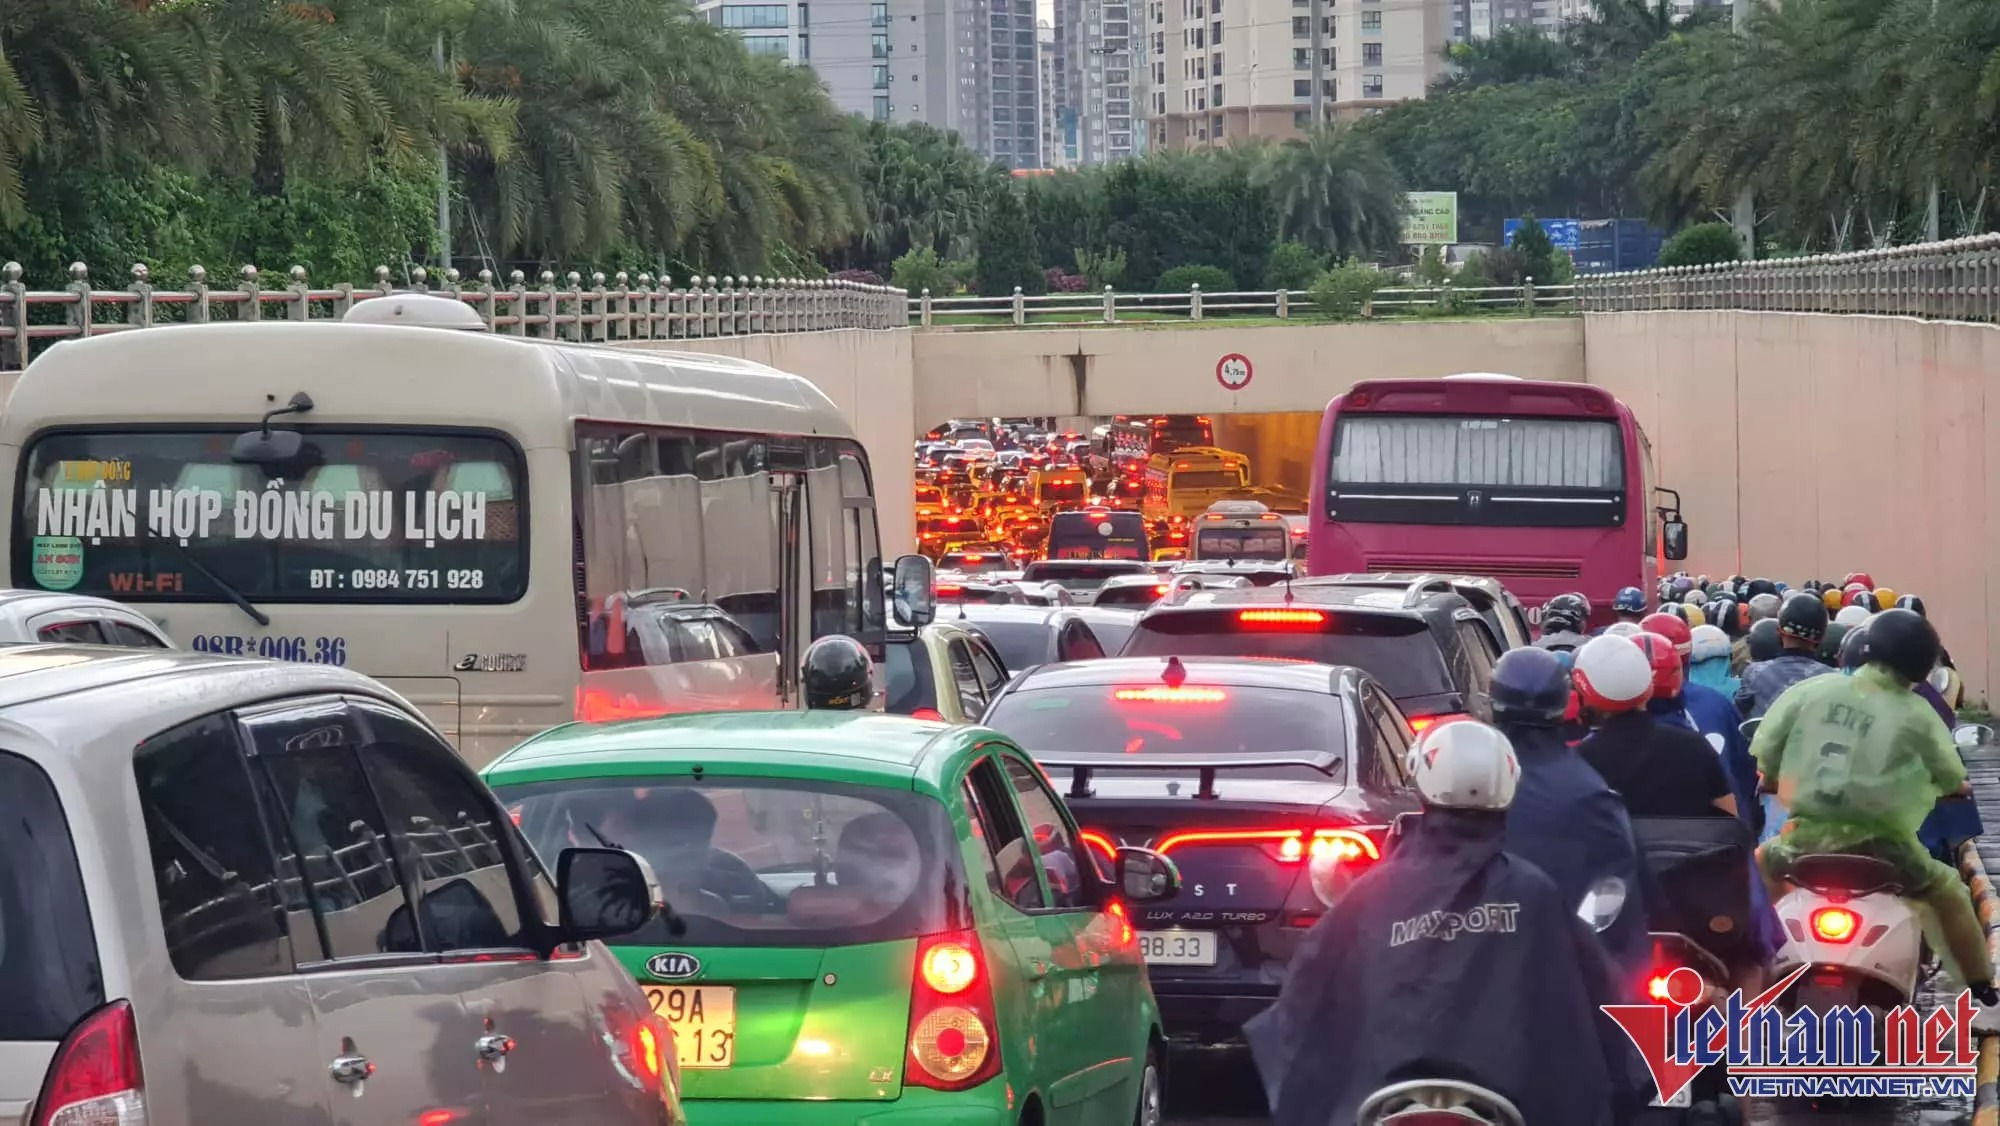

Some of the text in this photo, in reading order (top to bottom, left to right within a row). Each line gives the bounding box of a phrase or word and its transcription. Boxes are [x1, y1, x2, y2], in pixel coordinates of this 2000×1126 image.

[38, 477, 486, 548] NHẬN HỢP ĐỒNG DU LỊCH
[109, 573, 183, 592] Wi-Fi
[352, 569, 400, 589] 0984
[405, 569, 439, 589] 751
[447, 569, 484, 589] 928
[1146, 911, 1174, 921] LUX
[1221, 911, 1267, 921] TURBO
[1390, 903, 1520, 946] MAXPORT
[655, 958, 692, 973] KIA
[648, 989, 704, 1023] 29A
[672, 1028, 727, 1062] .13
